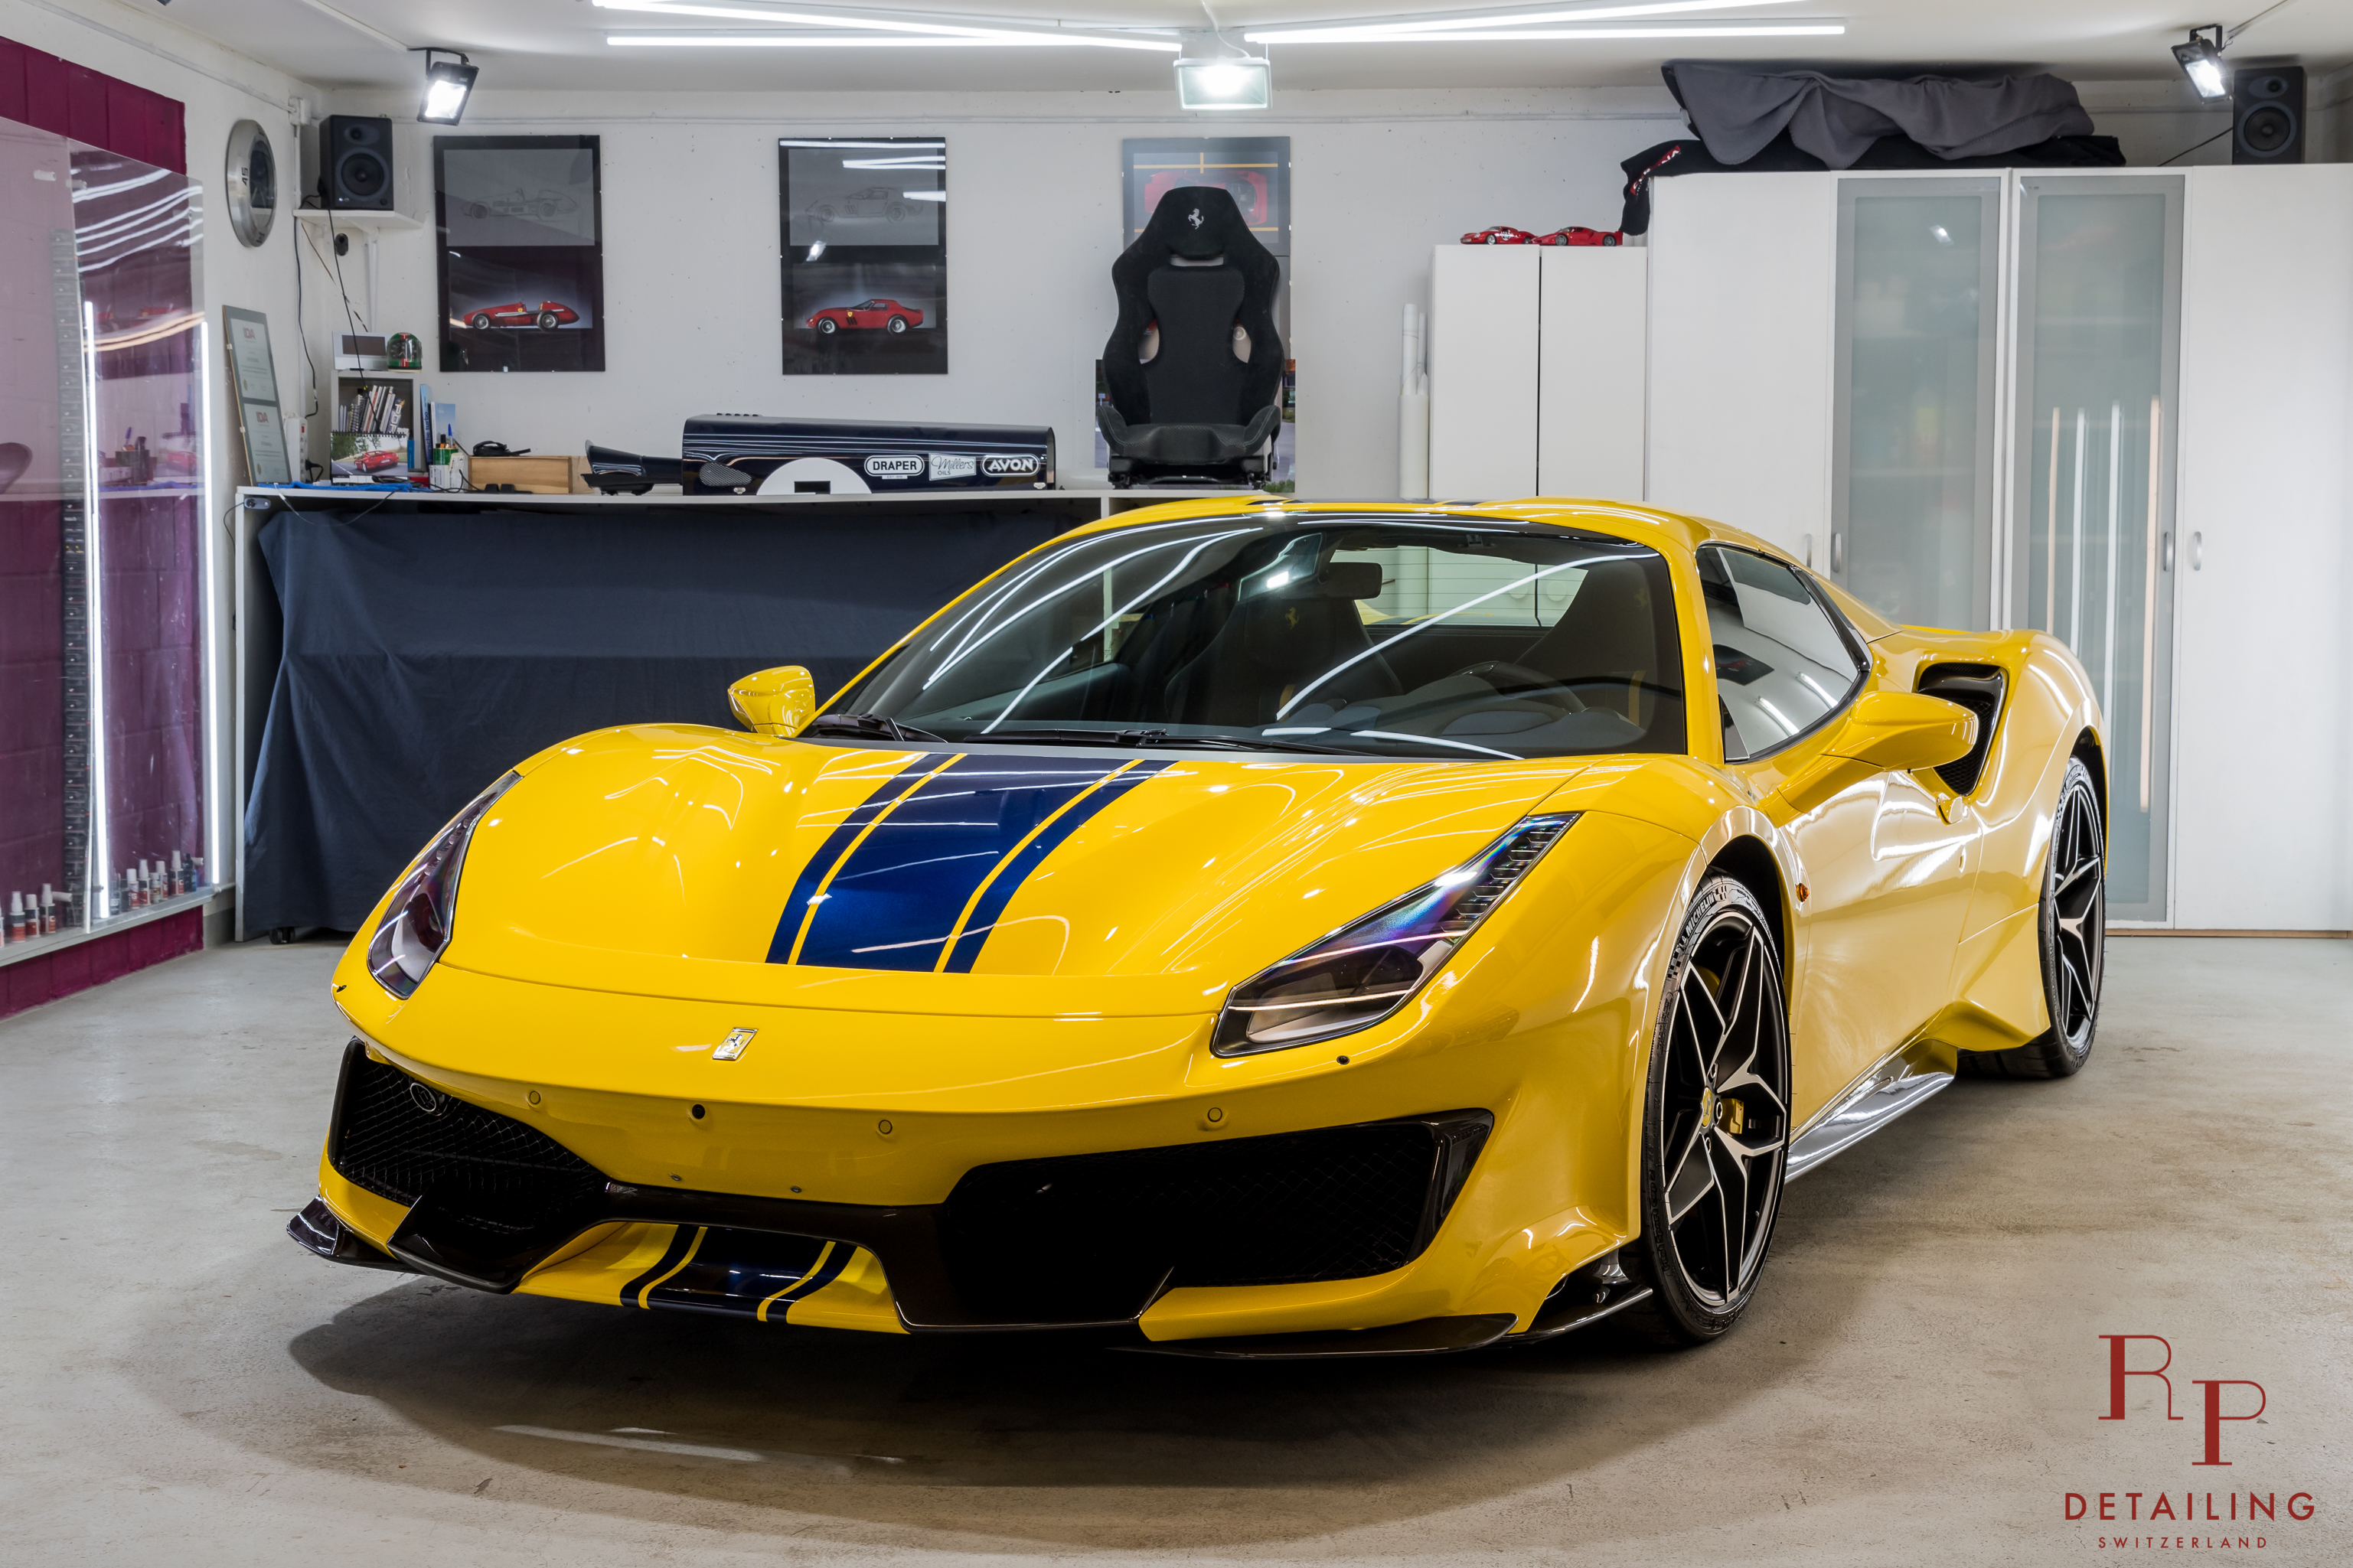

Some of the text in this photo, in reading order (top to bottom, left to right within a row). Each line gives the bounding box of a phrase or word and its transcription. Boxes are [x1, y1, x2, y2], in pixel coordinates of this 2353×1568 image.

[241, 167, 249, 187] 45
[873, 460, 917, 471] DRAPER
[931, 455, 974, 471] Millers
[987, 458, 1033, 472] AVON
[1685, 892, 1715, 937] MICHELIN
[1650, 1169, 1655, 1181] 2
[1652, 1208, 1663, 1244] Sport
[1658, 1244, 1669, 1272] Pilot
